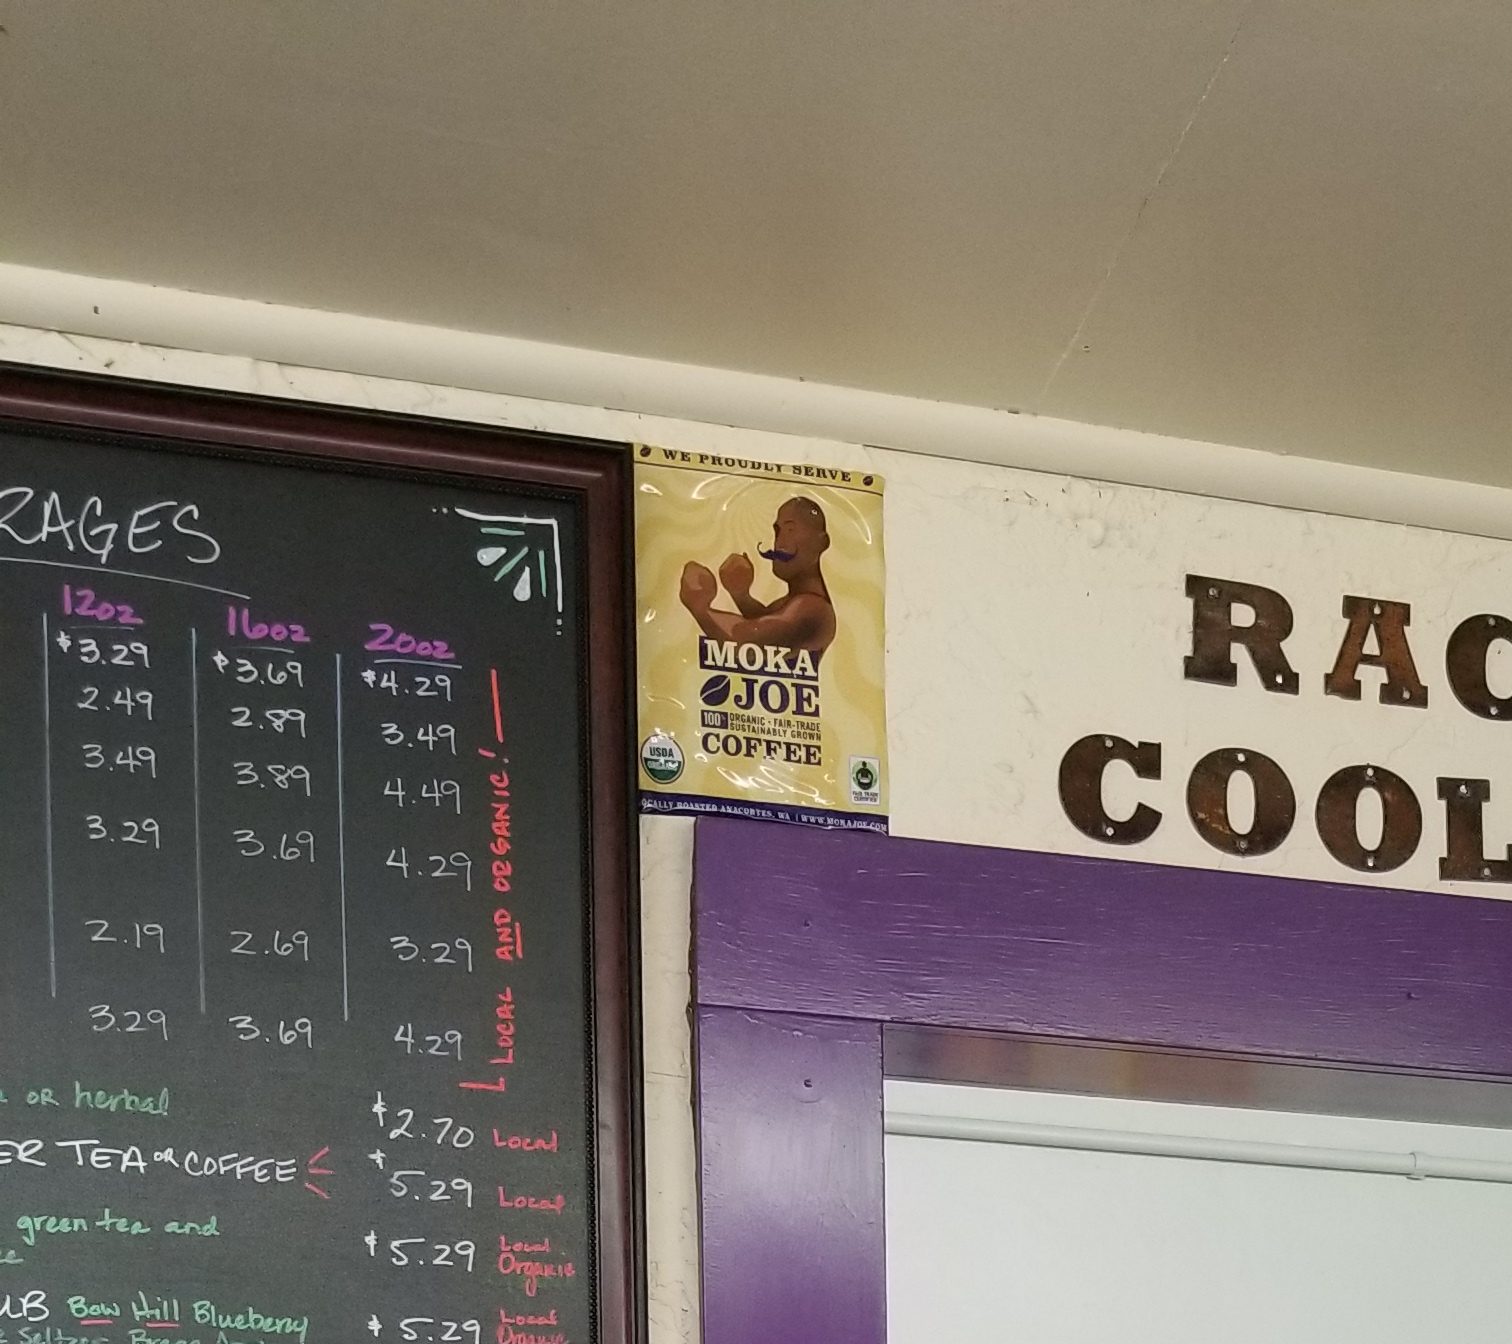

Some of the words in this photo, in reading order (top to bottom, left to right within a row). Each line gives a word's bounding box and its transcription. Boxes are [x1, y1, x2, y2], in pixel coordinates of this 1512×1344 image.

[662, 448, 691, 463] WE
[699, 453, 784, 473] PROUDLY
[792, 464, 851, 483] SERVE
[703, 638, 818, 678] MOKA
[77, 687, 152, 720] 2.49
[733, 677, 820, 717] JOE
[231, 707, 305, 738] 2.89
[381, 723, 456, 755] 3.49
[729, 712, 766, 726] ORGANIC
[773, 718, 821, 732] FAIR-TRADE
[729, 722, 788, 738] SUSTAINABLY
[790, 729, 822, 741] GROWN
[83, 744, 156, 778] 3.49
[649, 746, 675, 758] USDA
[701, 732, 822, 766] COFFEE
[234, 762, 310, 796] 3.89
[384, 778, 460, 814] 4.49
[86, 815, 159, 848] 3.29
[233, 830, 314, 862] 3.69
[386, 847, 471, 891] 4.29
[85, 920, 164, 953] 2.19
[231, 931, 308, 961] 2.69
[494, 909, 513, 960] AND
[390, 936, 472, 972] 3.29
[89, 1005, 168, 1040] 3.29
[229, 1016, 312, 1048] 3.69
[490, 987, 514, 1063] LOCAL
[395, 1023, 461, 1060] 4.29
[55, 1140, 147, 1174] TEA
[185, 1151, 296, 1182] COFFEE
[17, 1216, 87, 1245] green
[165, 1216, 219, 1235] and
